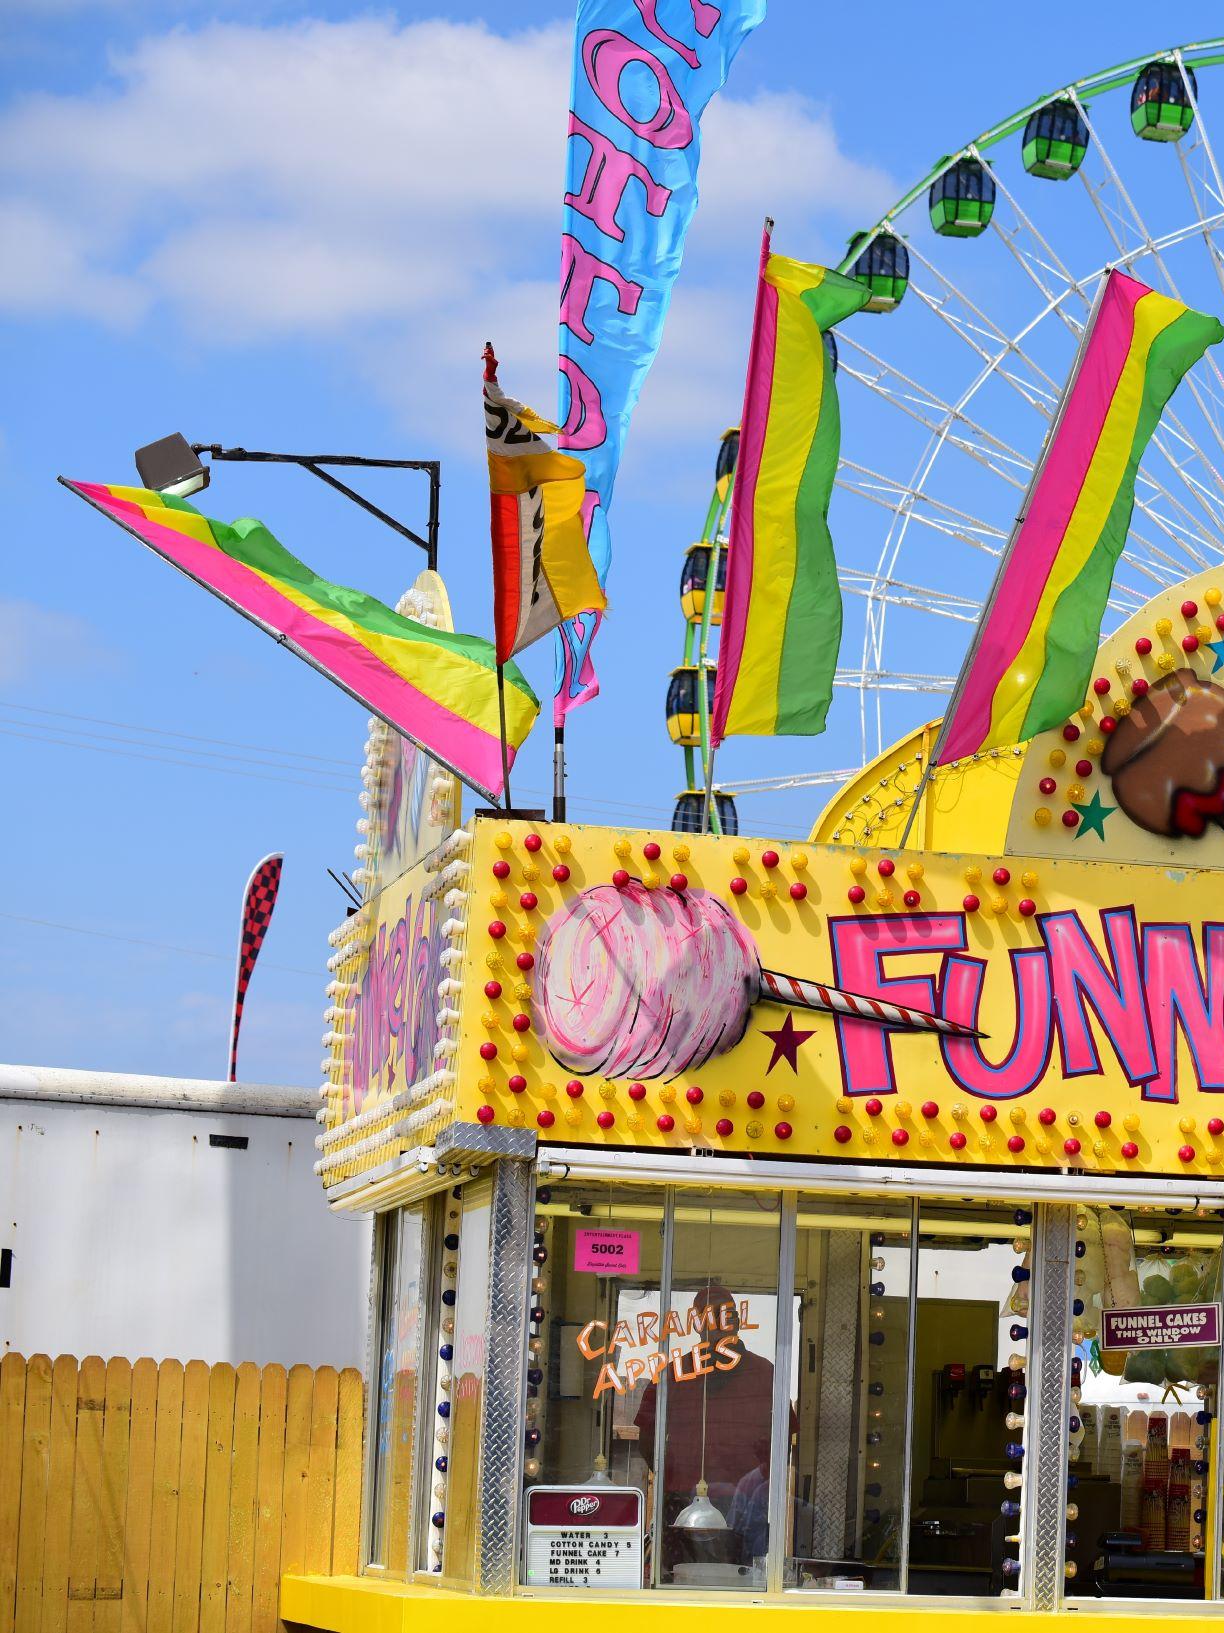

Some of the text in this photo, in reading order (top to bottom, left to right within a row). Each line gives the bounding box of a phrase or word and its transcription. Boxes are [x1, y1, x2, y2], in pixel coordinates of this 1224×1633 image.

[591, 1243, 624, 1255] 5002
[1110, 1312, 1208, 1330] FUNNEL CAKES
[576, 1300, 759, 1360] CARAMEL
[1116, 1326, 1201, 1339] THIS WINDOW
[1137, 1335, 1182, 1344] ONLY
[593, 1335, 742, 1400] APPLES
[571, 1499, 598, 1513] Pepper
